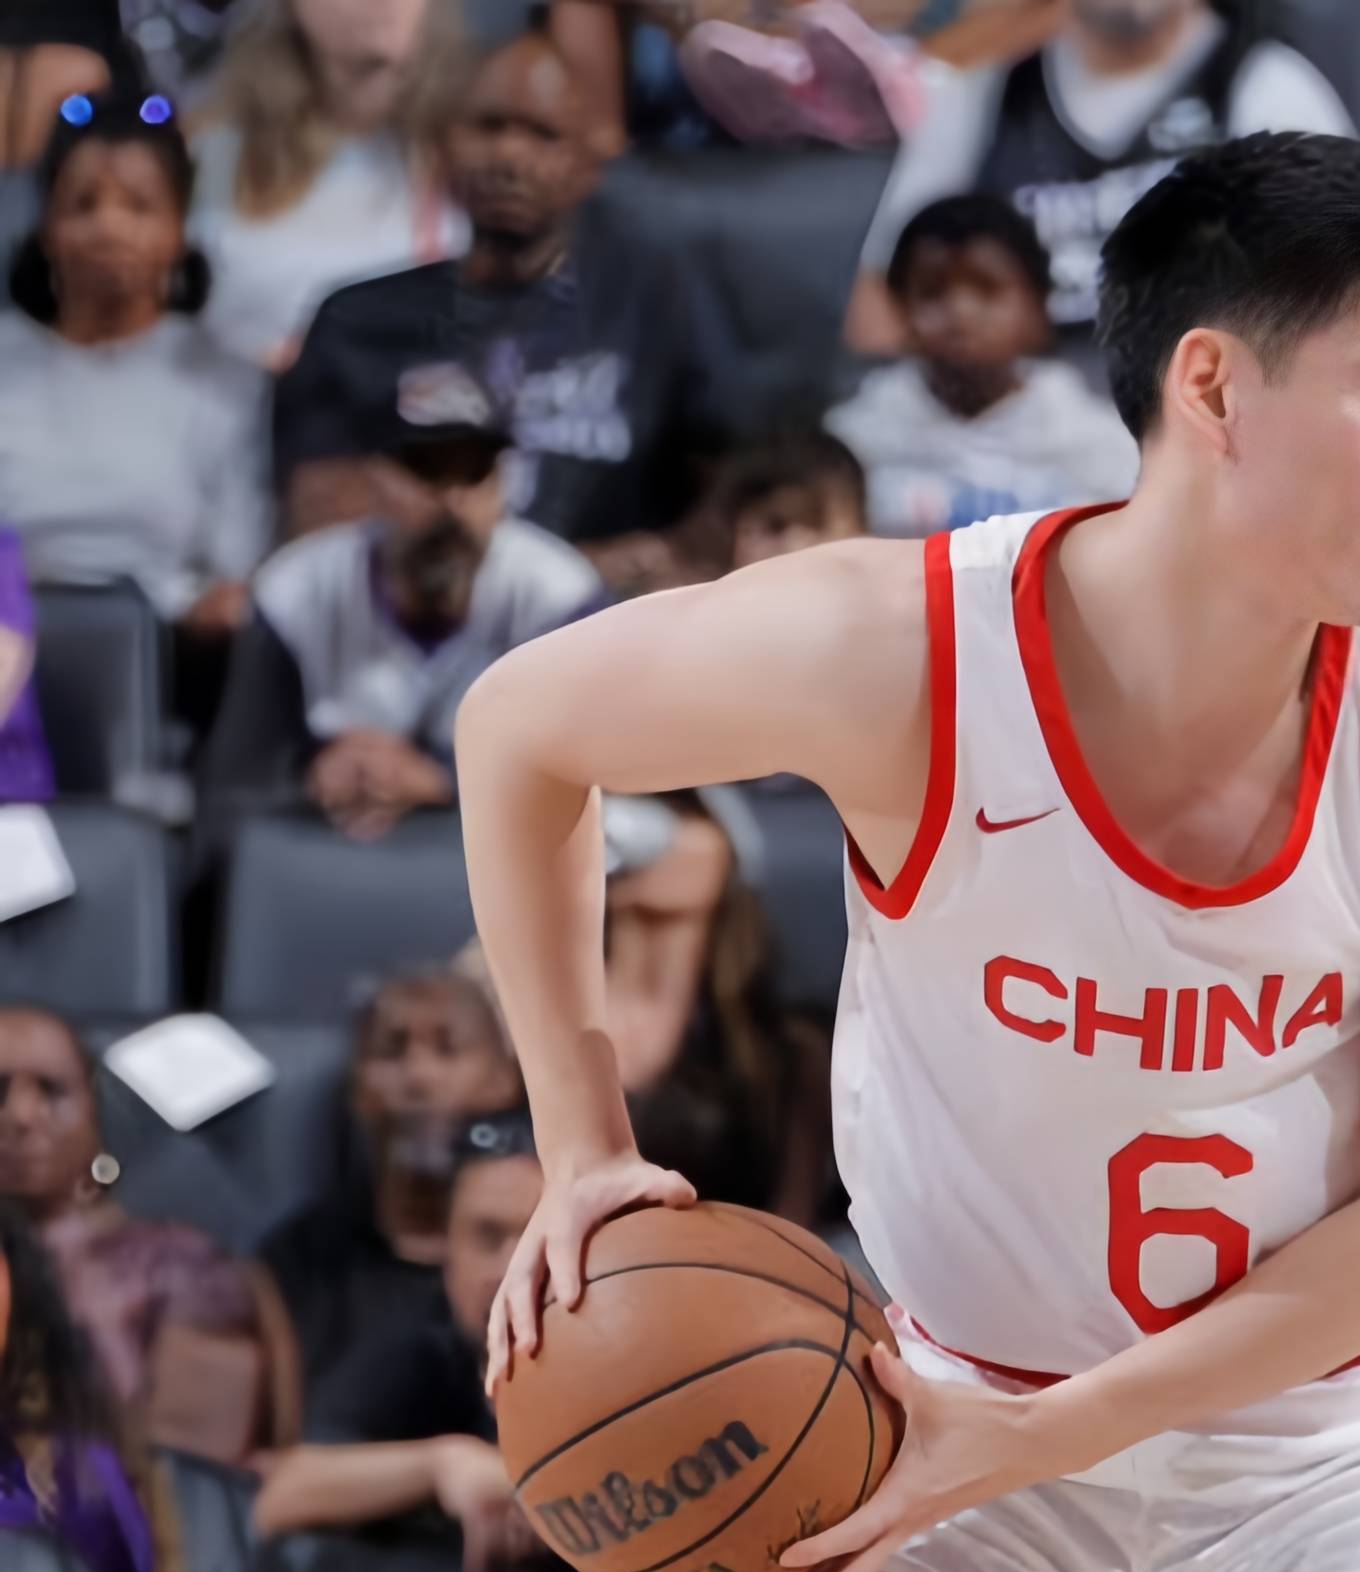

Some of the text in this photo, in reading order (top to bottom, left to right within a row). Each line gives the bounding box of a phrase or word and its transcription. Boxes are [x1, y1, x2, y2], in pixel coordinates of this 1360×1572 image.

[984, 954, 1343, 1072] CHINA
[1107, 1131, 1254, 1336] 6
[535, 1420, 769, 1555] Wilson
